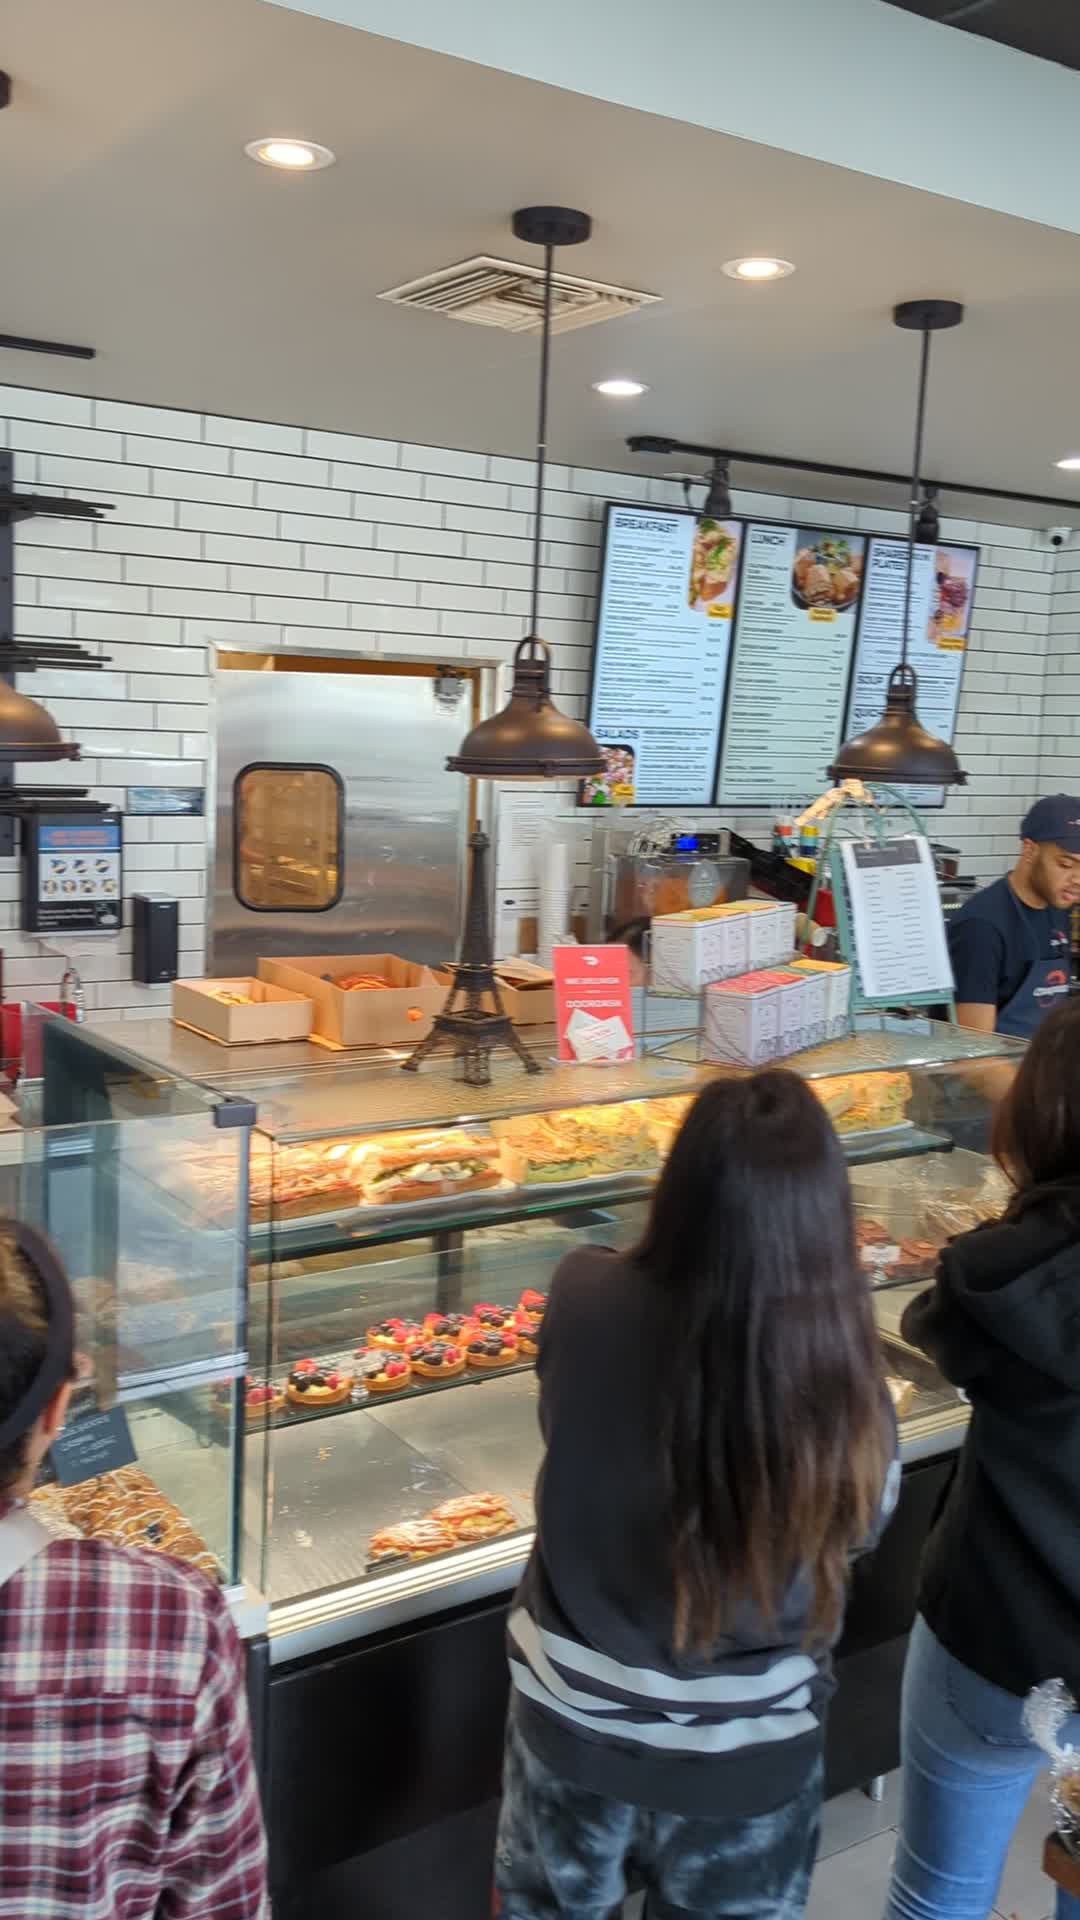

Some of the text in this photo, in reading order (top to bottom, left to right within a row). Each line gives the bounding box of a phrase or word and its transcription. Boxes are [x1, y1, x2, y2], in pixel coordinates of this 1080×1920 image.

[615, 517, 679, 533] BREAKFAST
[752, 534, 786, 546] LUNCH
[871, 558, 907, 571] PLATES
[856, 675, 884, 685] SOUP
[594, 728, 640, 739] SALADS
